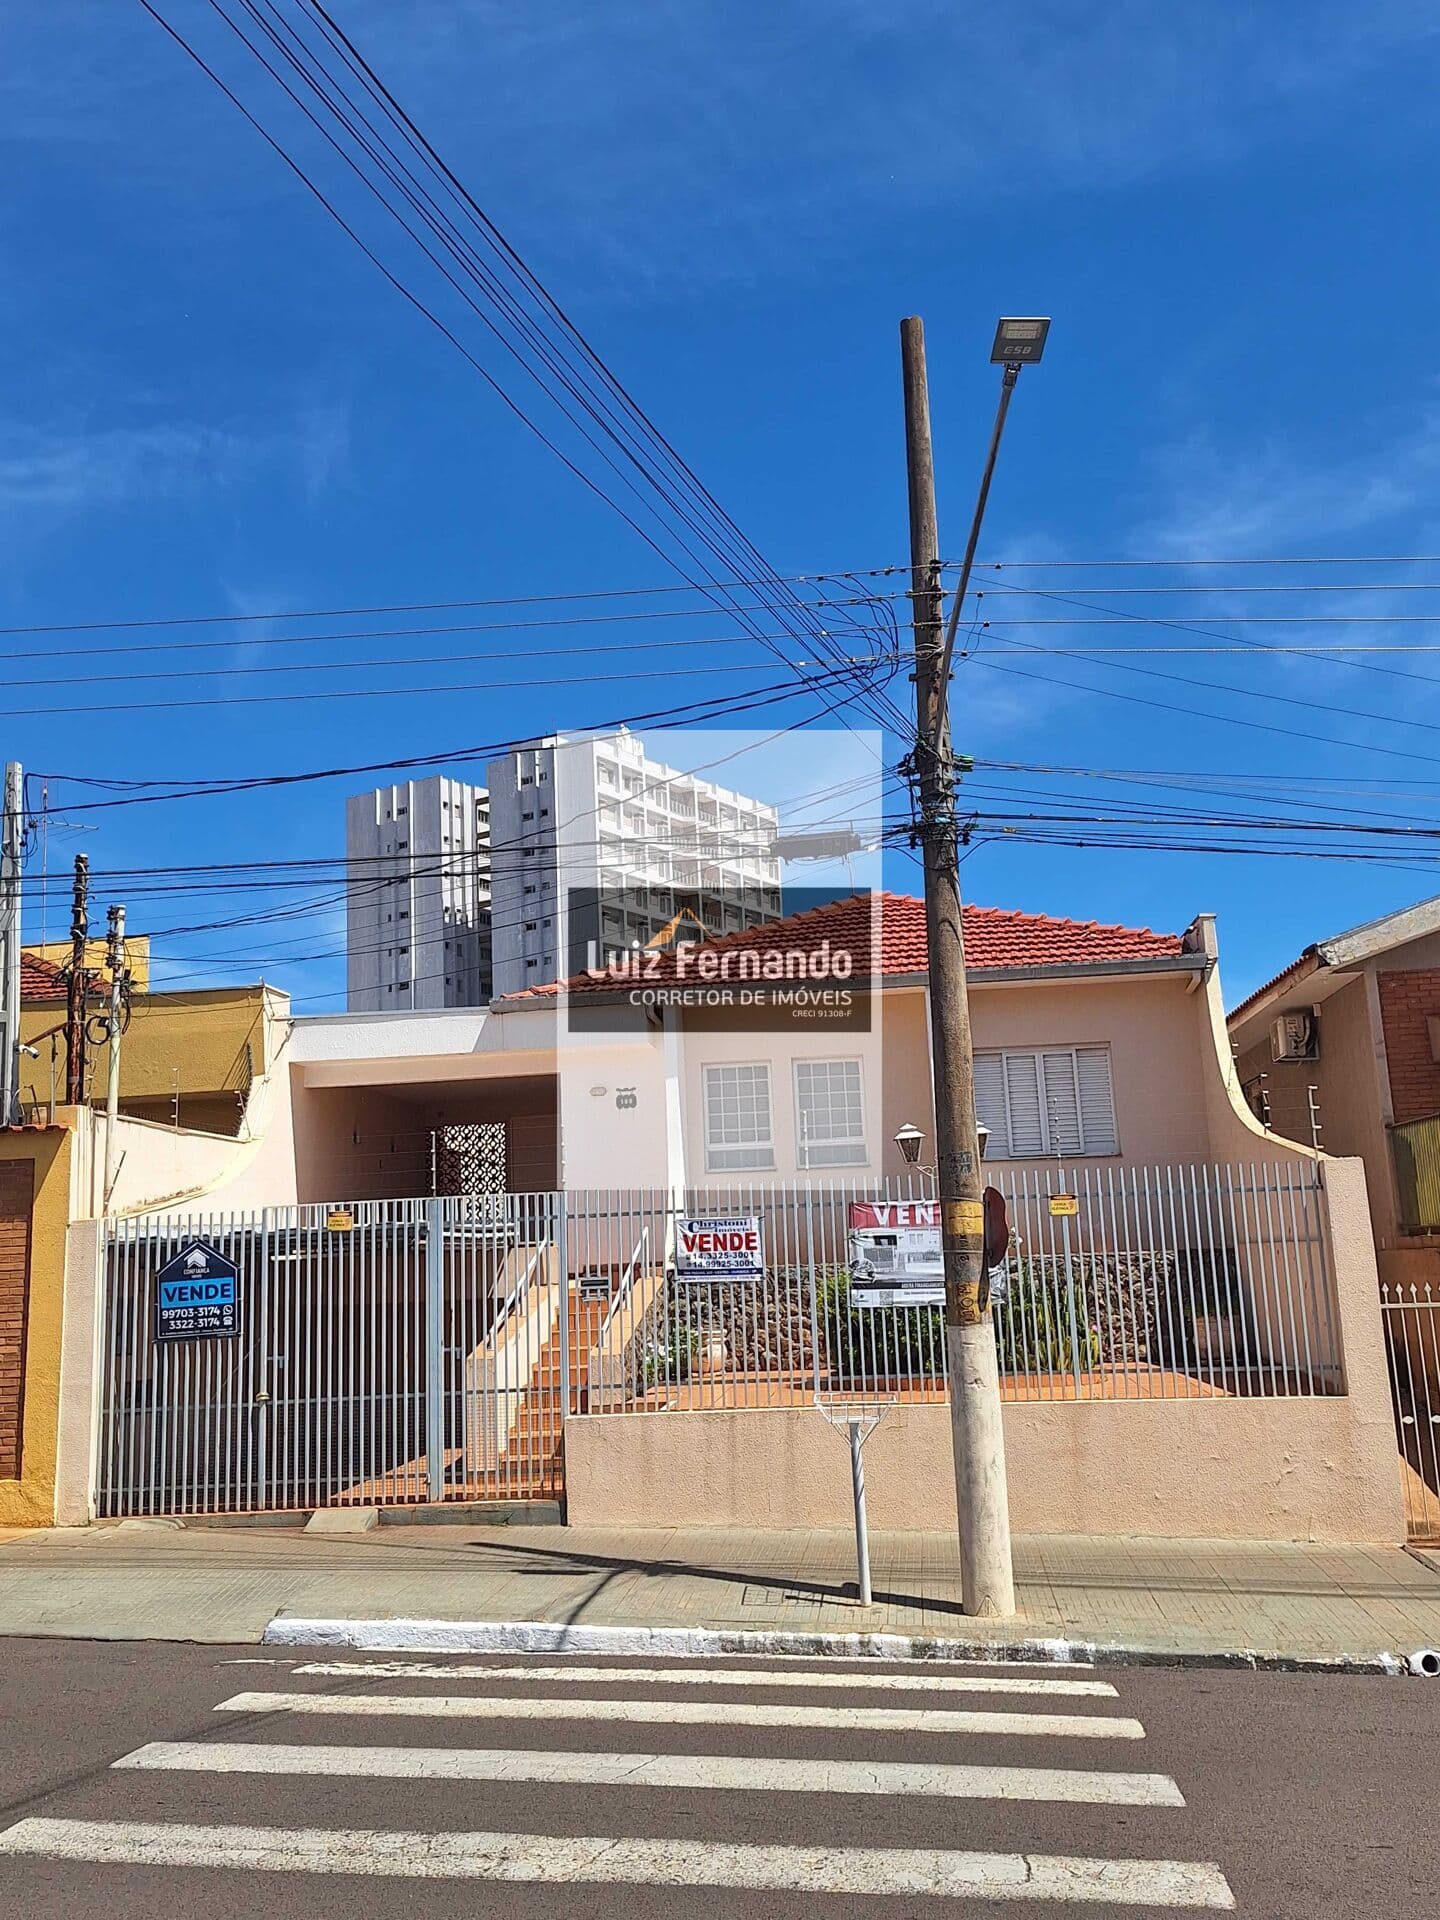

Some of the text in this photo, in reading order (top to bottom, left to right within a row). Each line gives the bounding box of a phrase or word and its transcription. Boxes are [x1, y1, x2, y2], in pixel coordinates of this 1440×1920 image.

[683, 1232, 757, 1253] VENDE
[164, 1283, 231, 1303] VENDE
[162, 1306, 220, 1319] 99703-3174
[169, 1317, 220, 1330] 3322-3174
